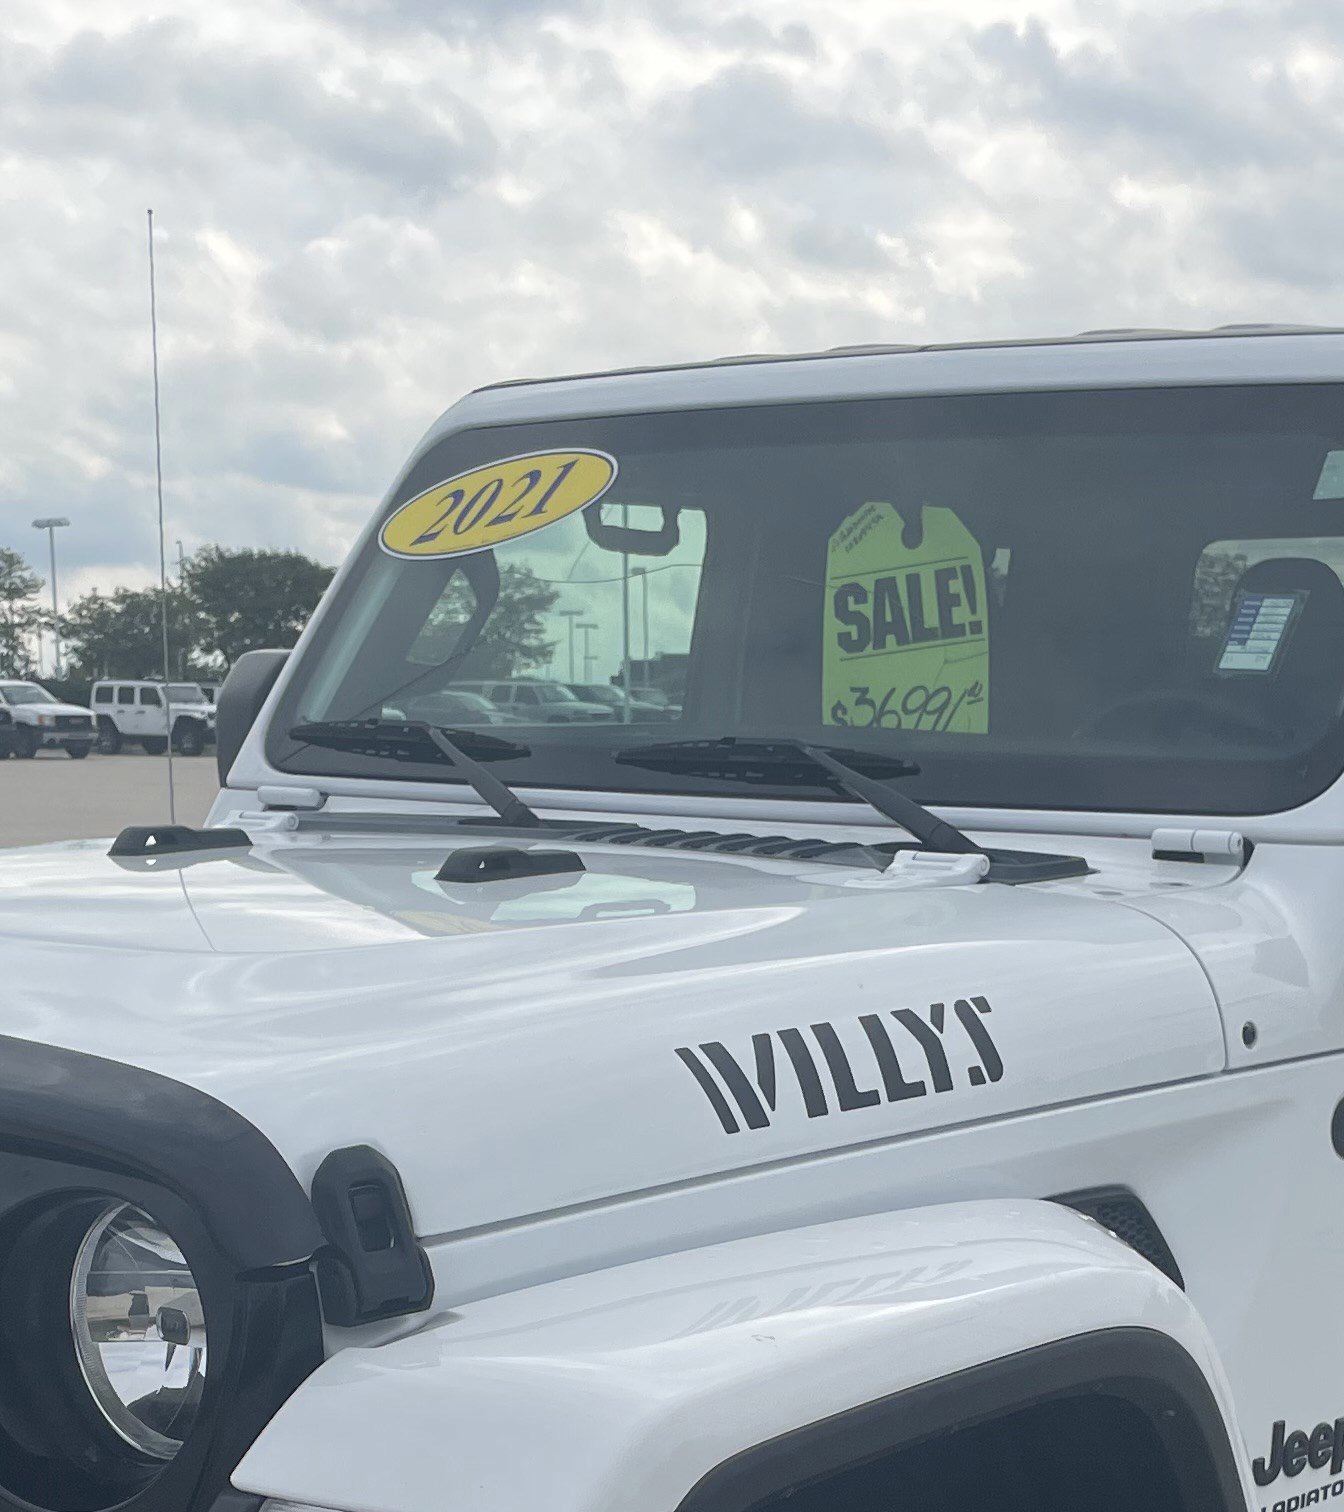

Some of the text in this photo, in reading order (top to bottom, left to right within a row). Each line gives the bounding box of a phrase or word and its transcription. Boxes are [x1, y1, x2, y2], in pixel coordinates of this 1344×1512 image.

[409, 458, 580, 547] 2021
[833, 564, 983, 654] SALE!
[674, 996, 1004, 1134] WILLYS
